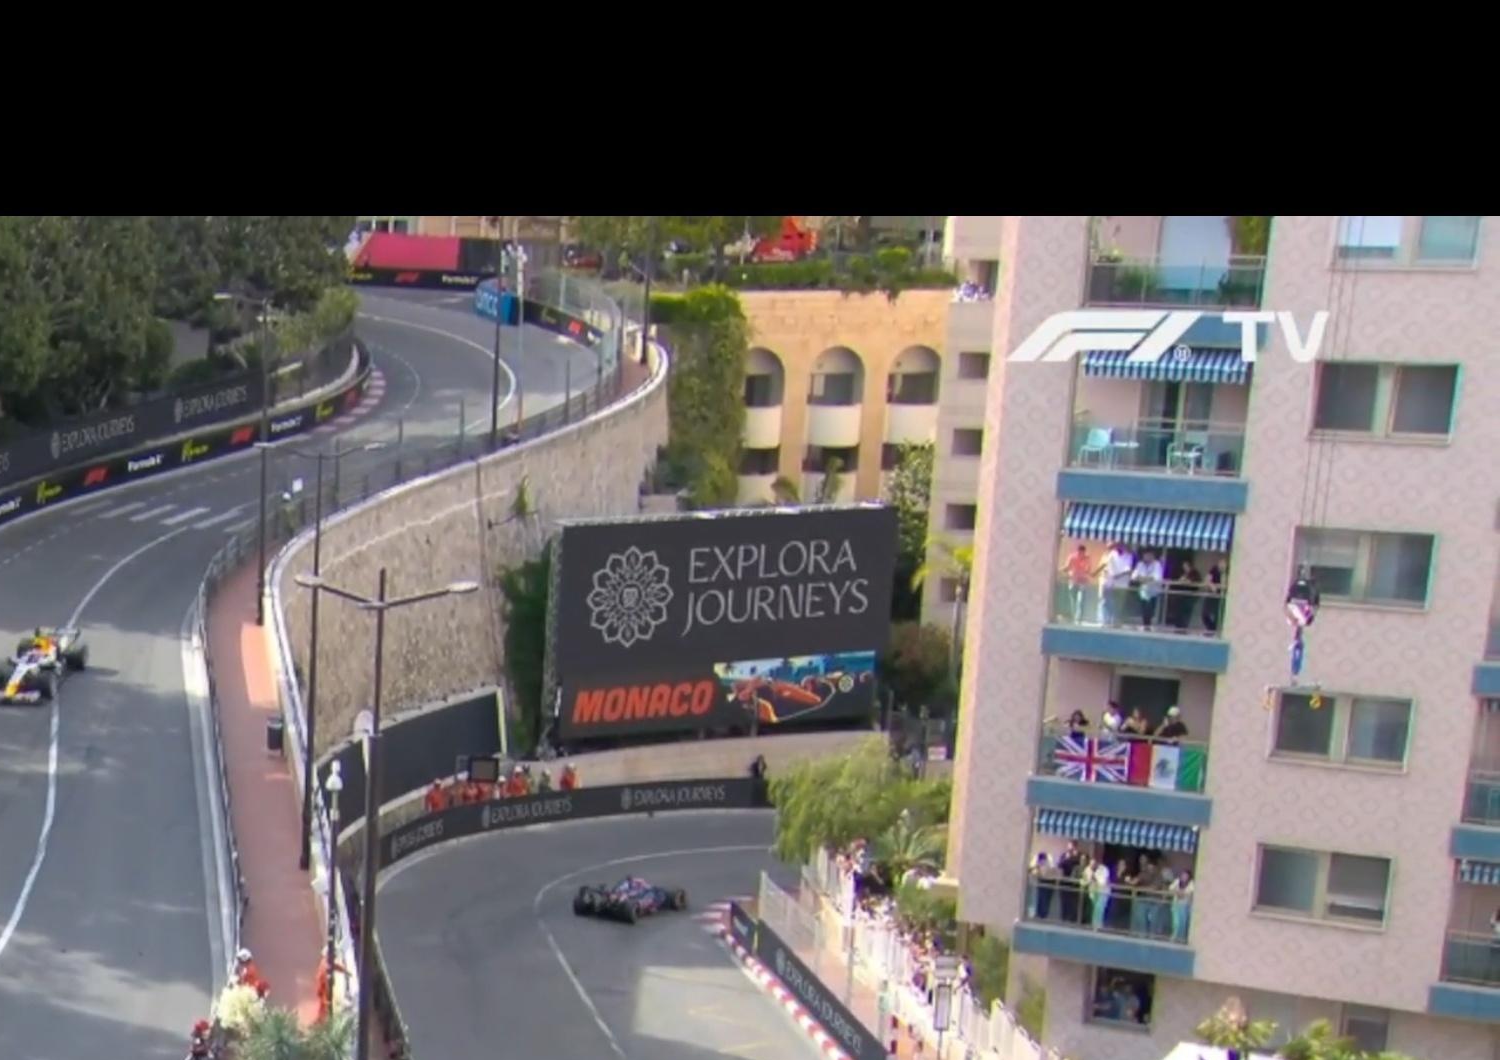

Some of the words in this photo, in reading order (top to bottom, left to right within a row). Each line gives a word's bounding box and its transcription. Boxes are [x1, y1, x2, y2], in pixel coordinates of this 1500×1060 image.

[688, 538, 858, 585] EXPLORA
[680, 578, 870, 638] JOURNEYS
[573, 679, 715, 724] MONACO
